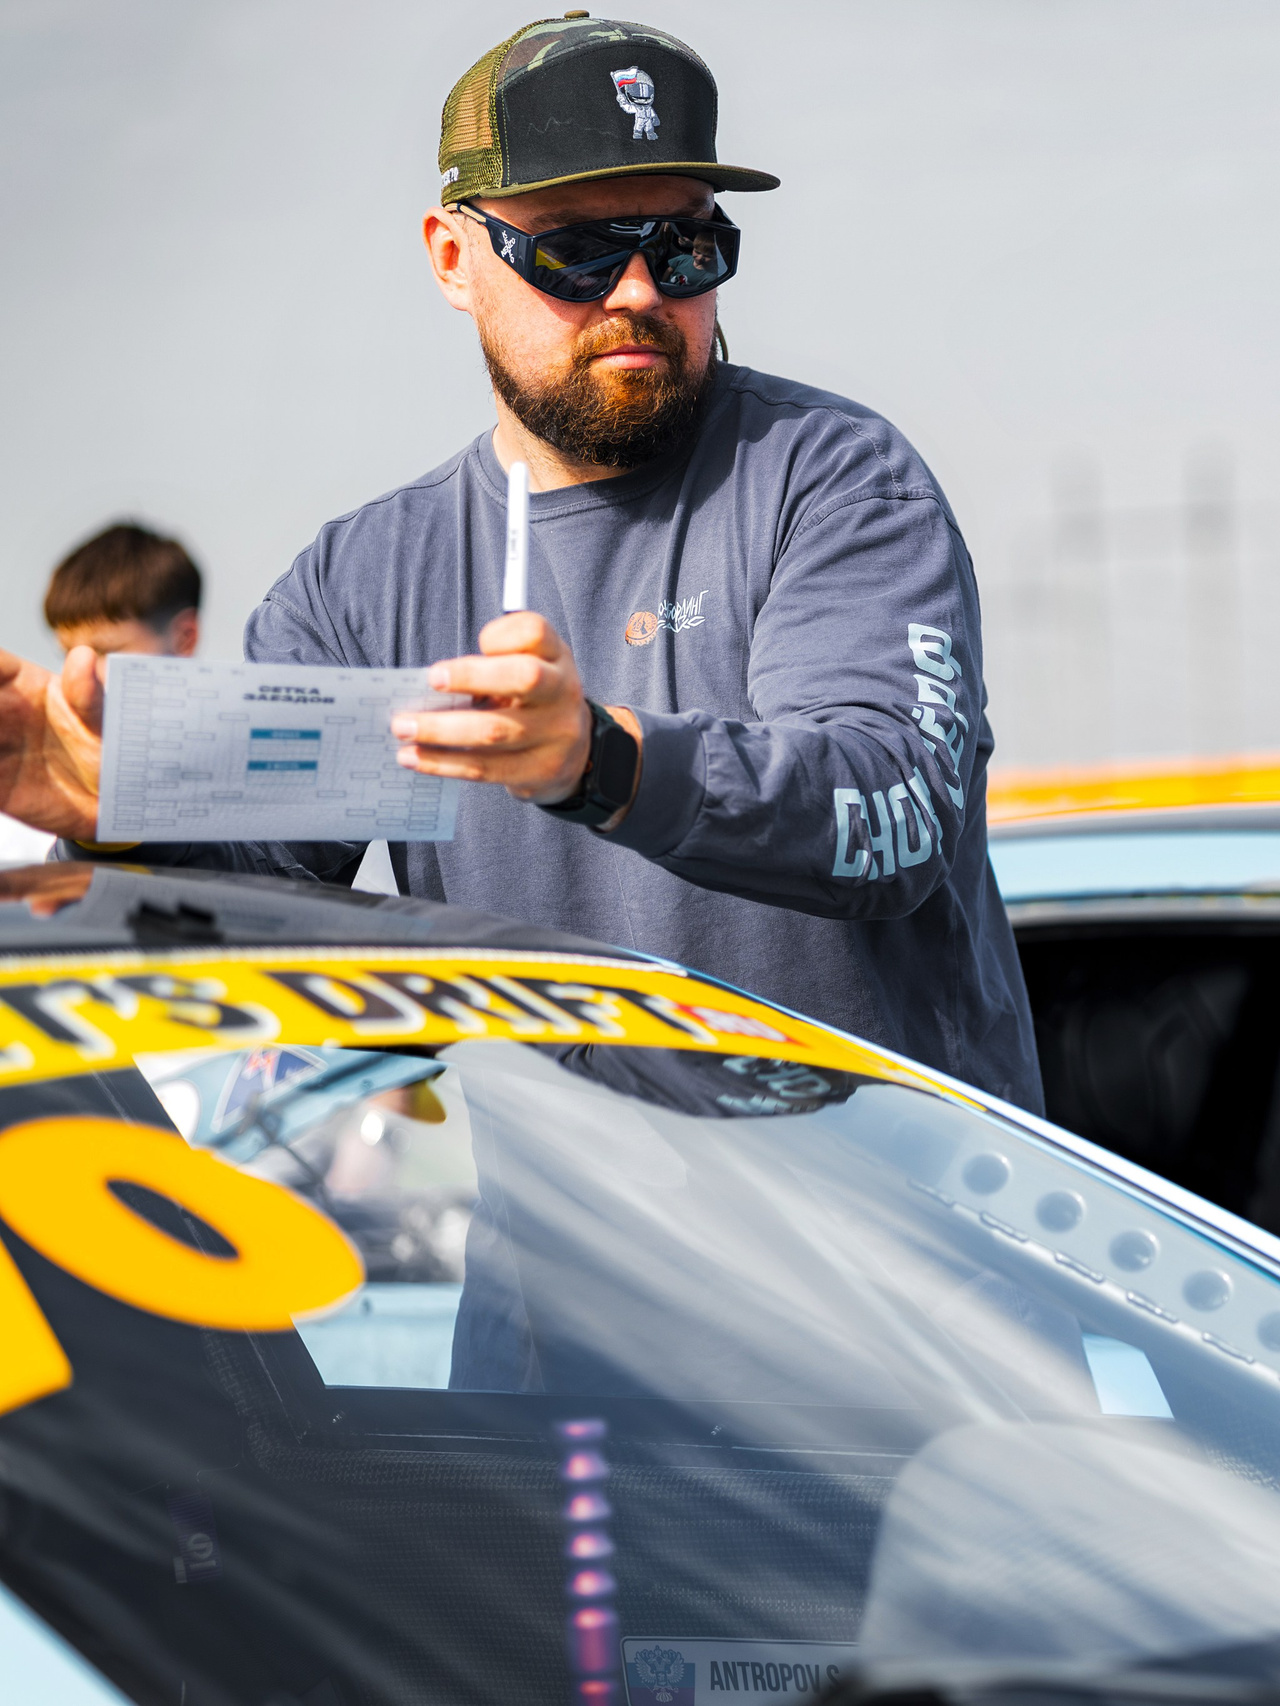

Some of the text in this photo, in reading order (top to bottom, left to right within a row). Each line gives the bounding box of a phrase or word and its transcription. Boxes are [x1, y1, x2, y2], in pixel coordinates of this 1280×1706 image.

[243, 693, 336, 705] ЗАЕЗДОВ
[258, 685, 321, 695] СЕТКА
[0, 971, 283, 1072] T'S
[255, 970, 719, 1046] DRIFT
[709, 1660, 820, 1693] ANTROPOV
